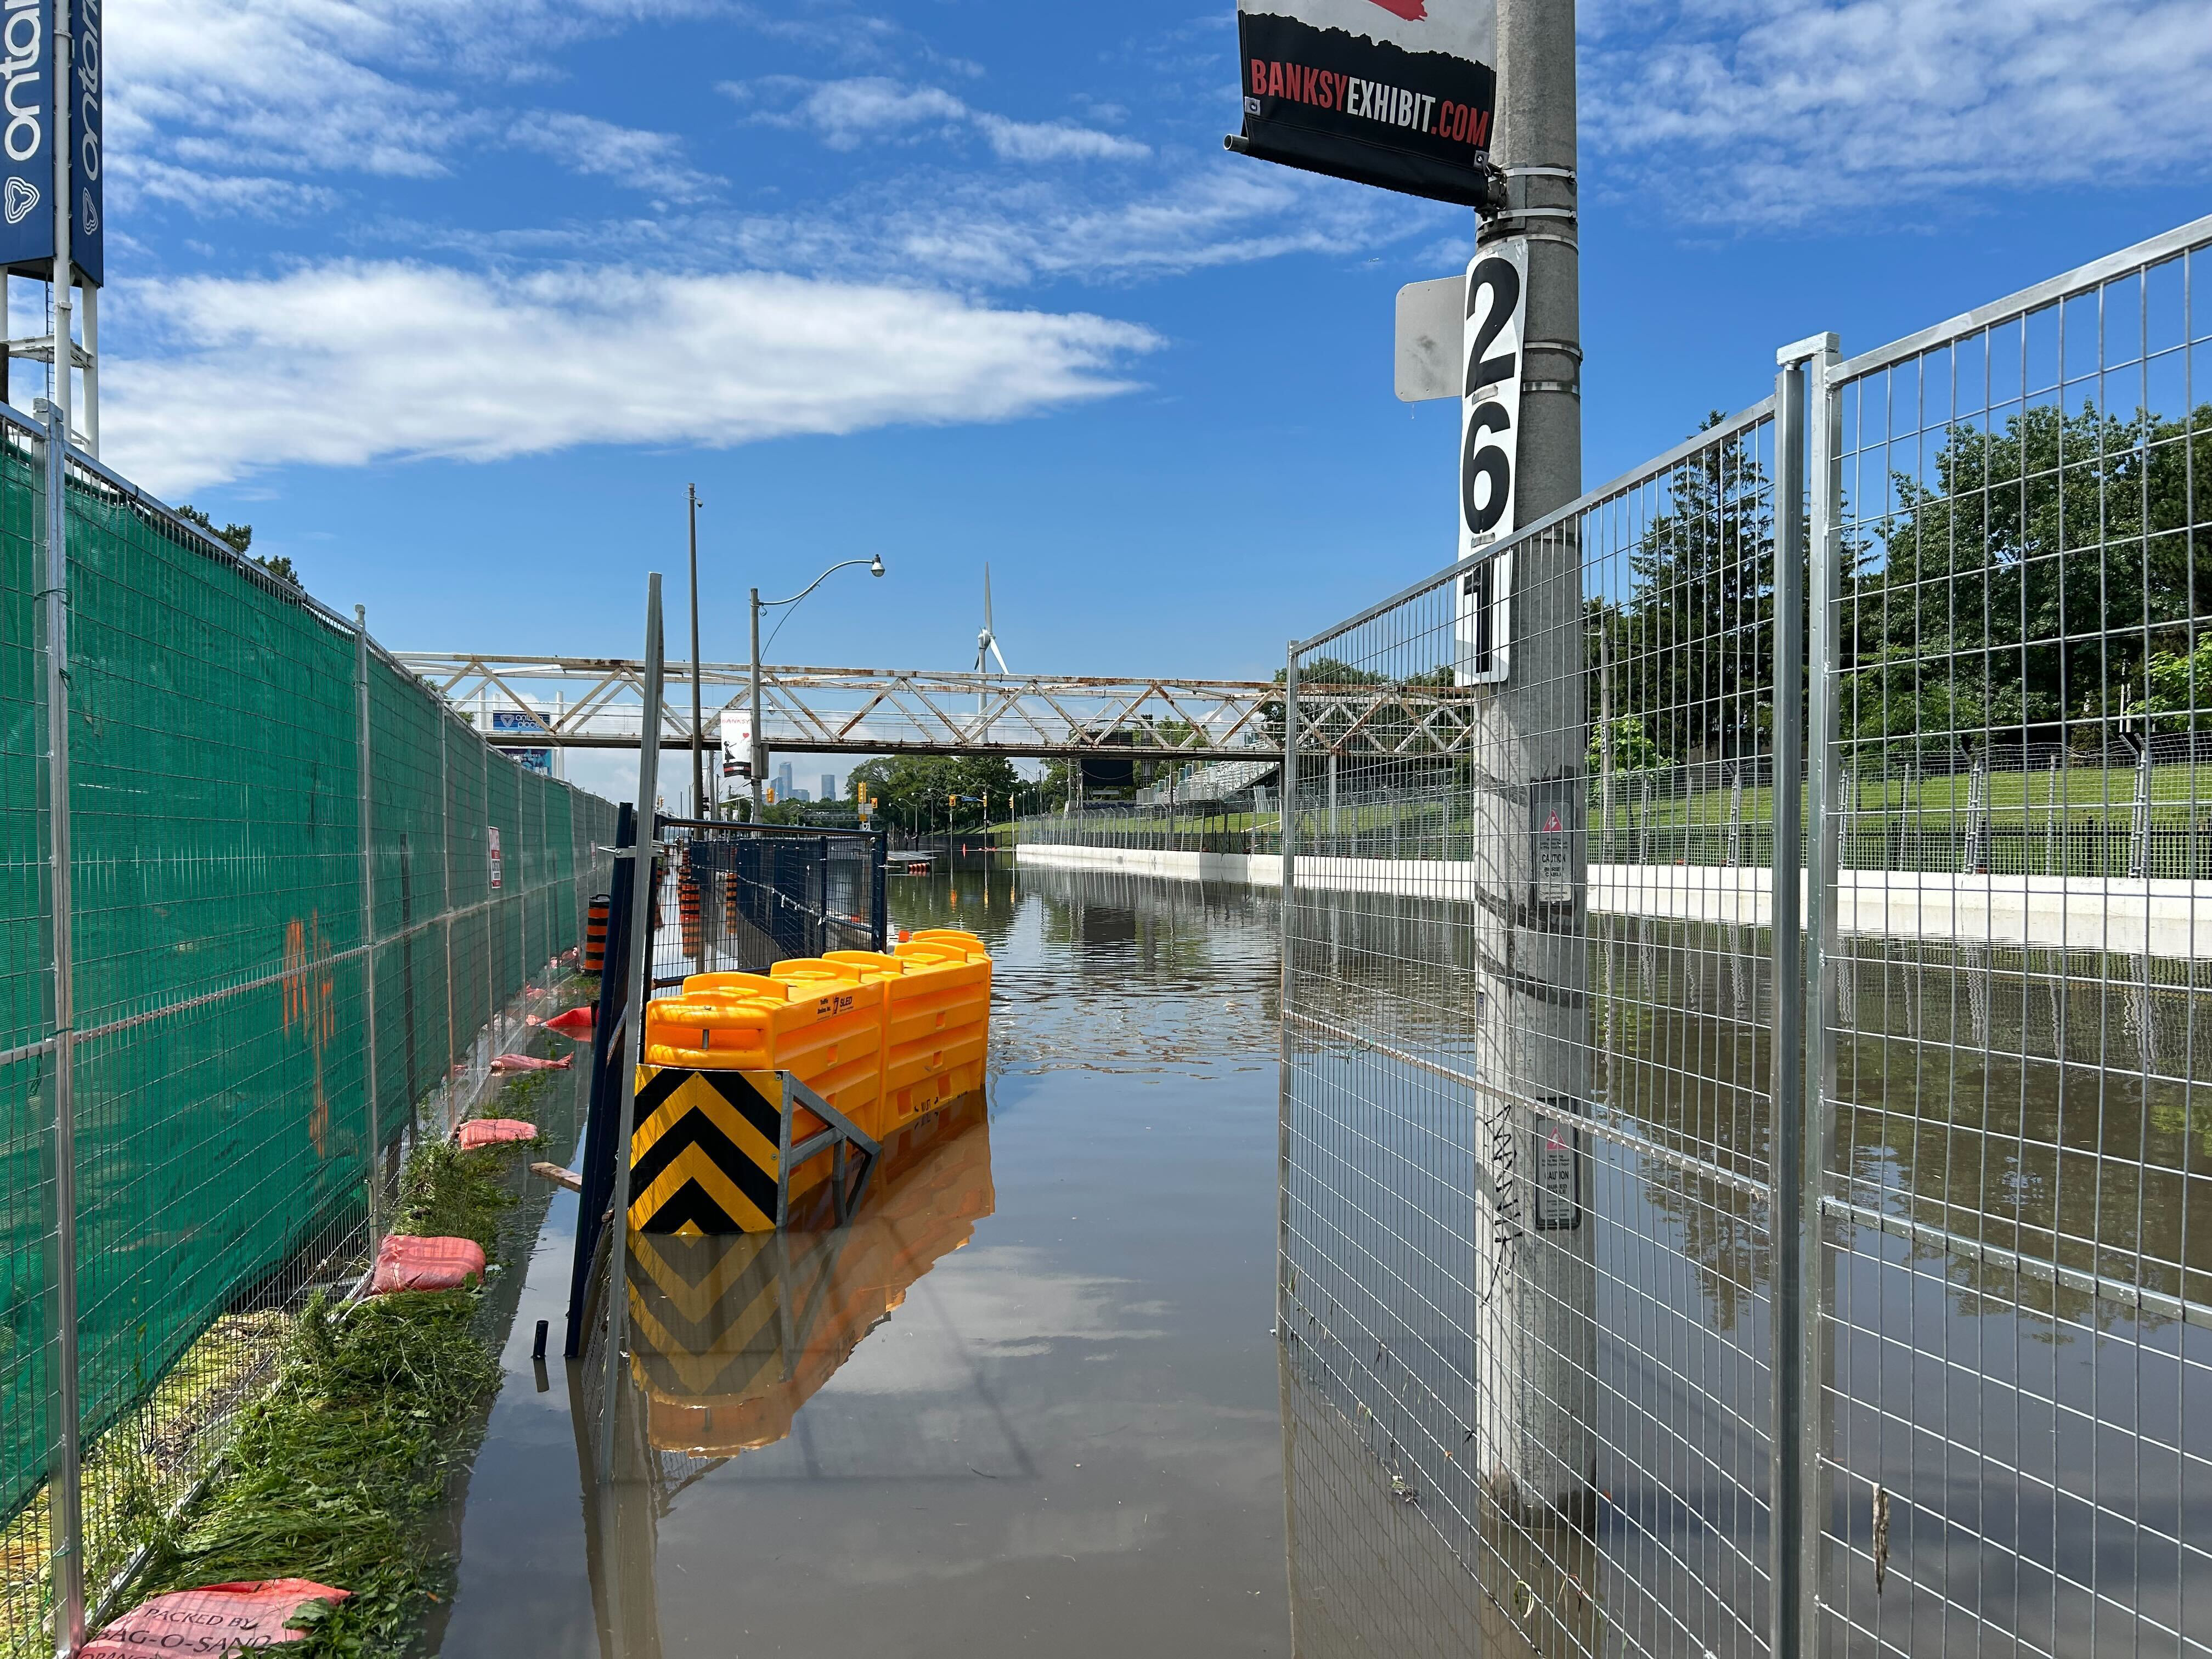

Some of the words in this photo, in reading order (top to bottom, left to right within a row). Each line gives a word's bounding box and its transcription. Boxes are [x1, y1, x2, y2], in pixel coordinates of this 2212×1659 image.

[1250, 58, 1489, 148] BANKSYEXHIBIT.COM
[1462, 256, 1520, 673] 261
[144, 1608, 223, 1626] PACKED
[228, 1617, 258, 1628] BY
